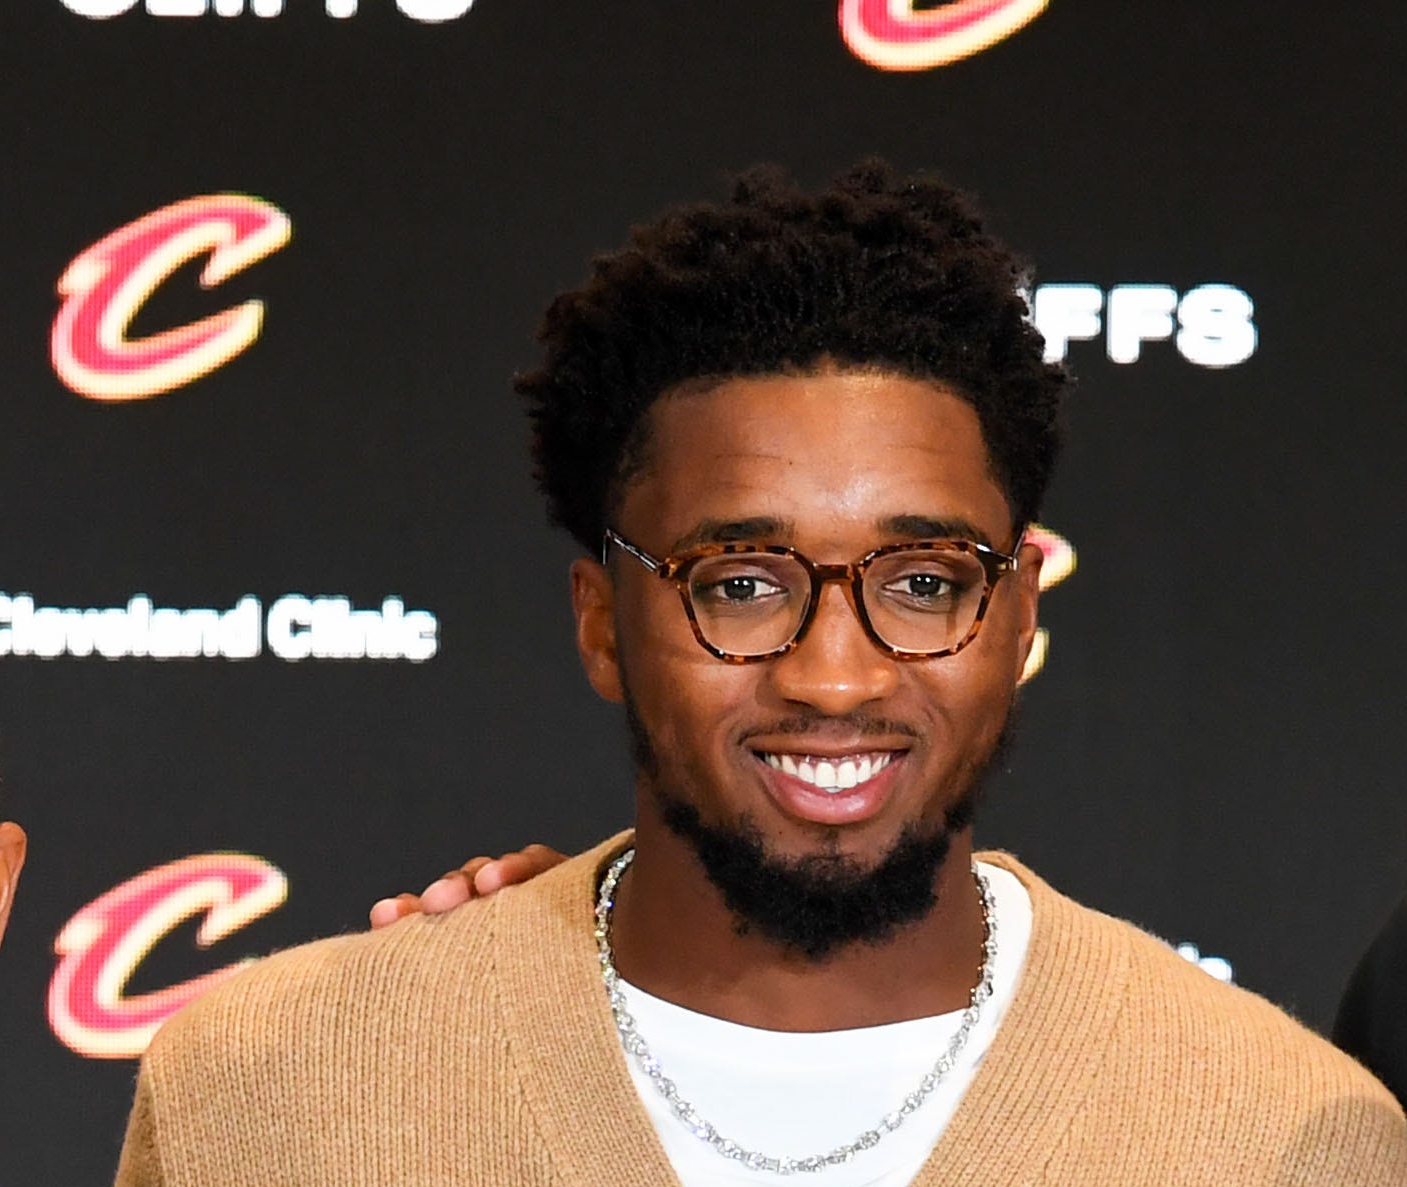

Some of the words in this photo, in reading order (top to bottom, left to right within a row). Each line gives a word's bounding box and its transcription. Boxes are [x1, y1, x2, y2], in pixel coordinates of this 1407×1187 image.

[49, 194, 291, 402] C
[267, 594, 437, 663] Clinic
[45, 851, 289, 1058] C
